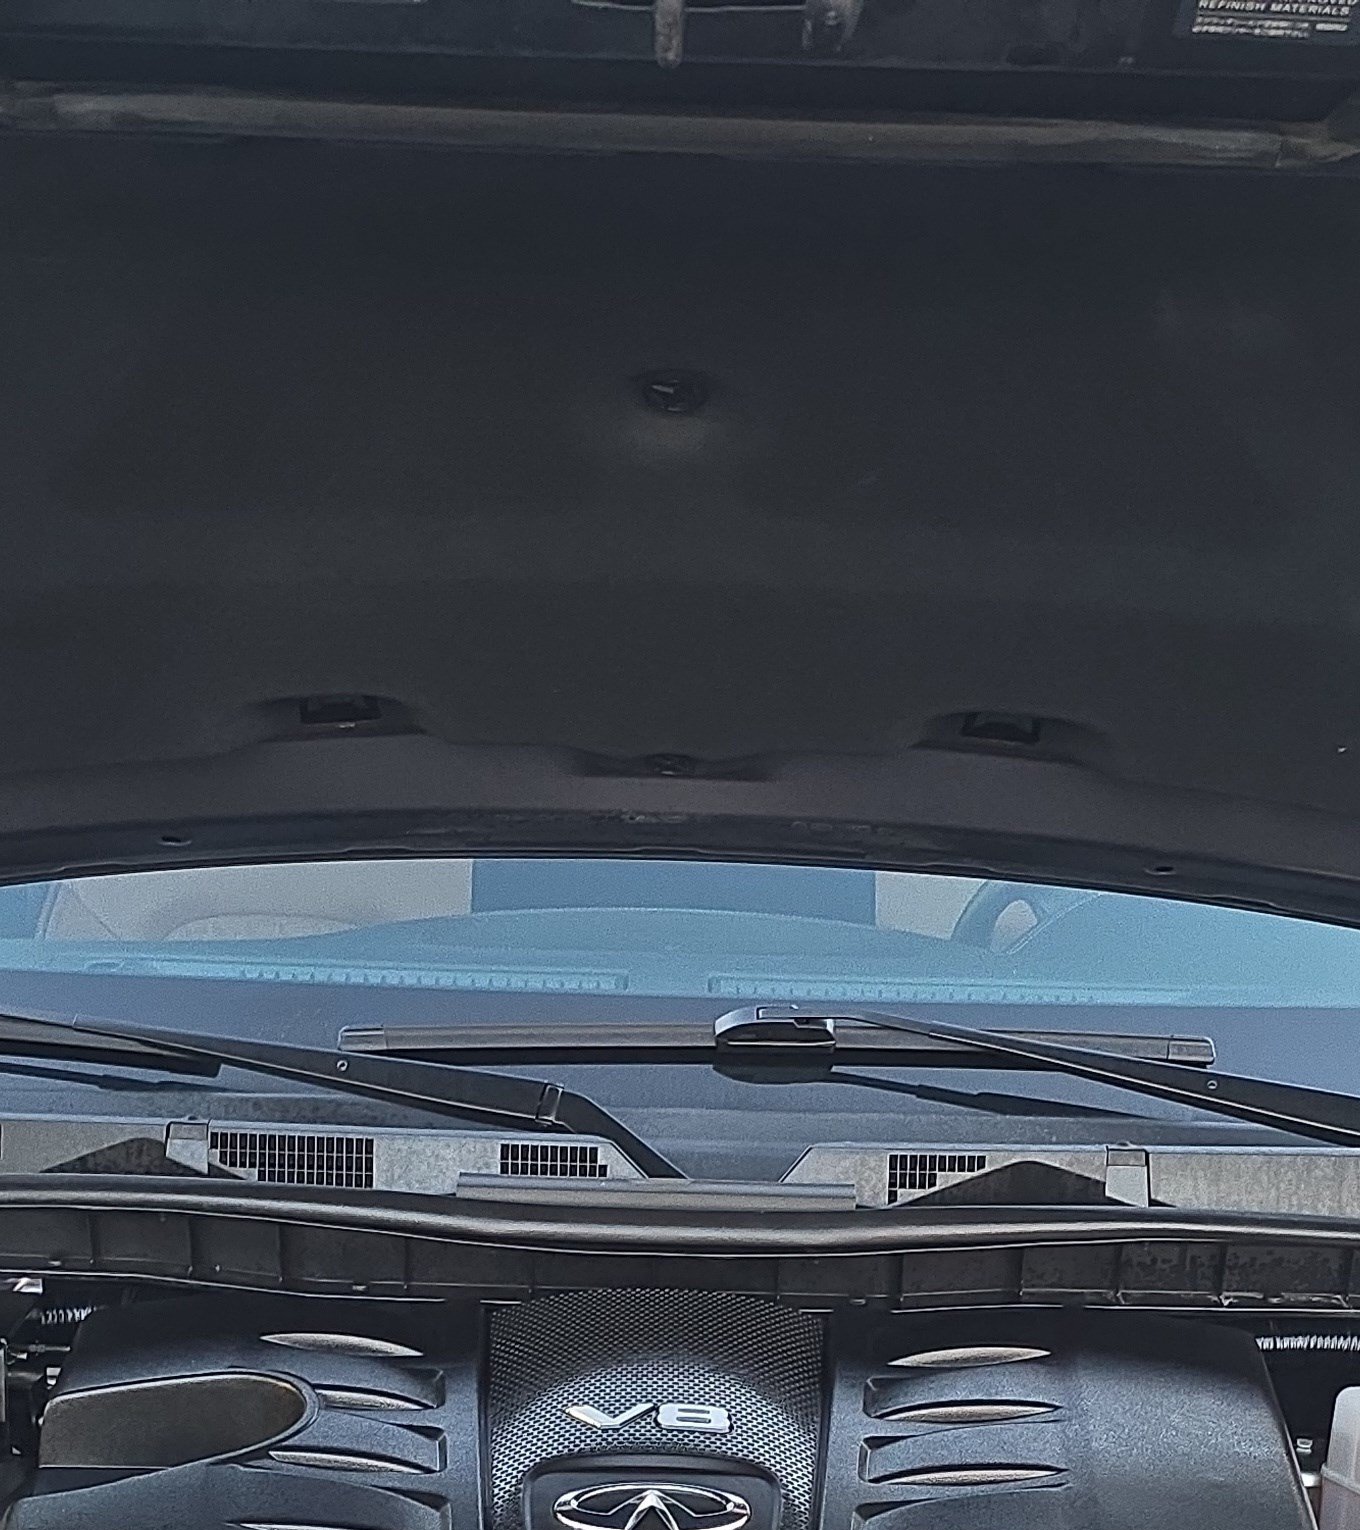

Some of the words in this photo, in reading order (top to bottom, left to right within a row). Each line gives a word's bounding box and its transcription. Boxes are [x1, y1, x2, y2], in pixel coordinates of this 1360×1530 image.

[1198, 1, 1266, 11] REFINISH
[1269, 3, 1350, 16] MATERIALS
[562, 1401, 734, 1433] V8
